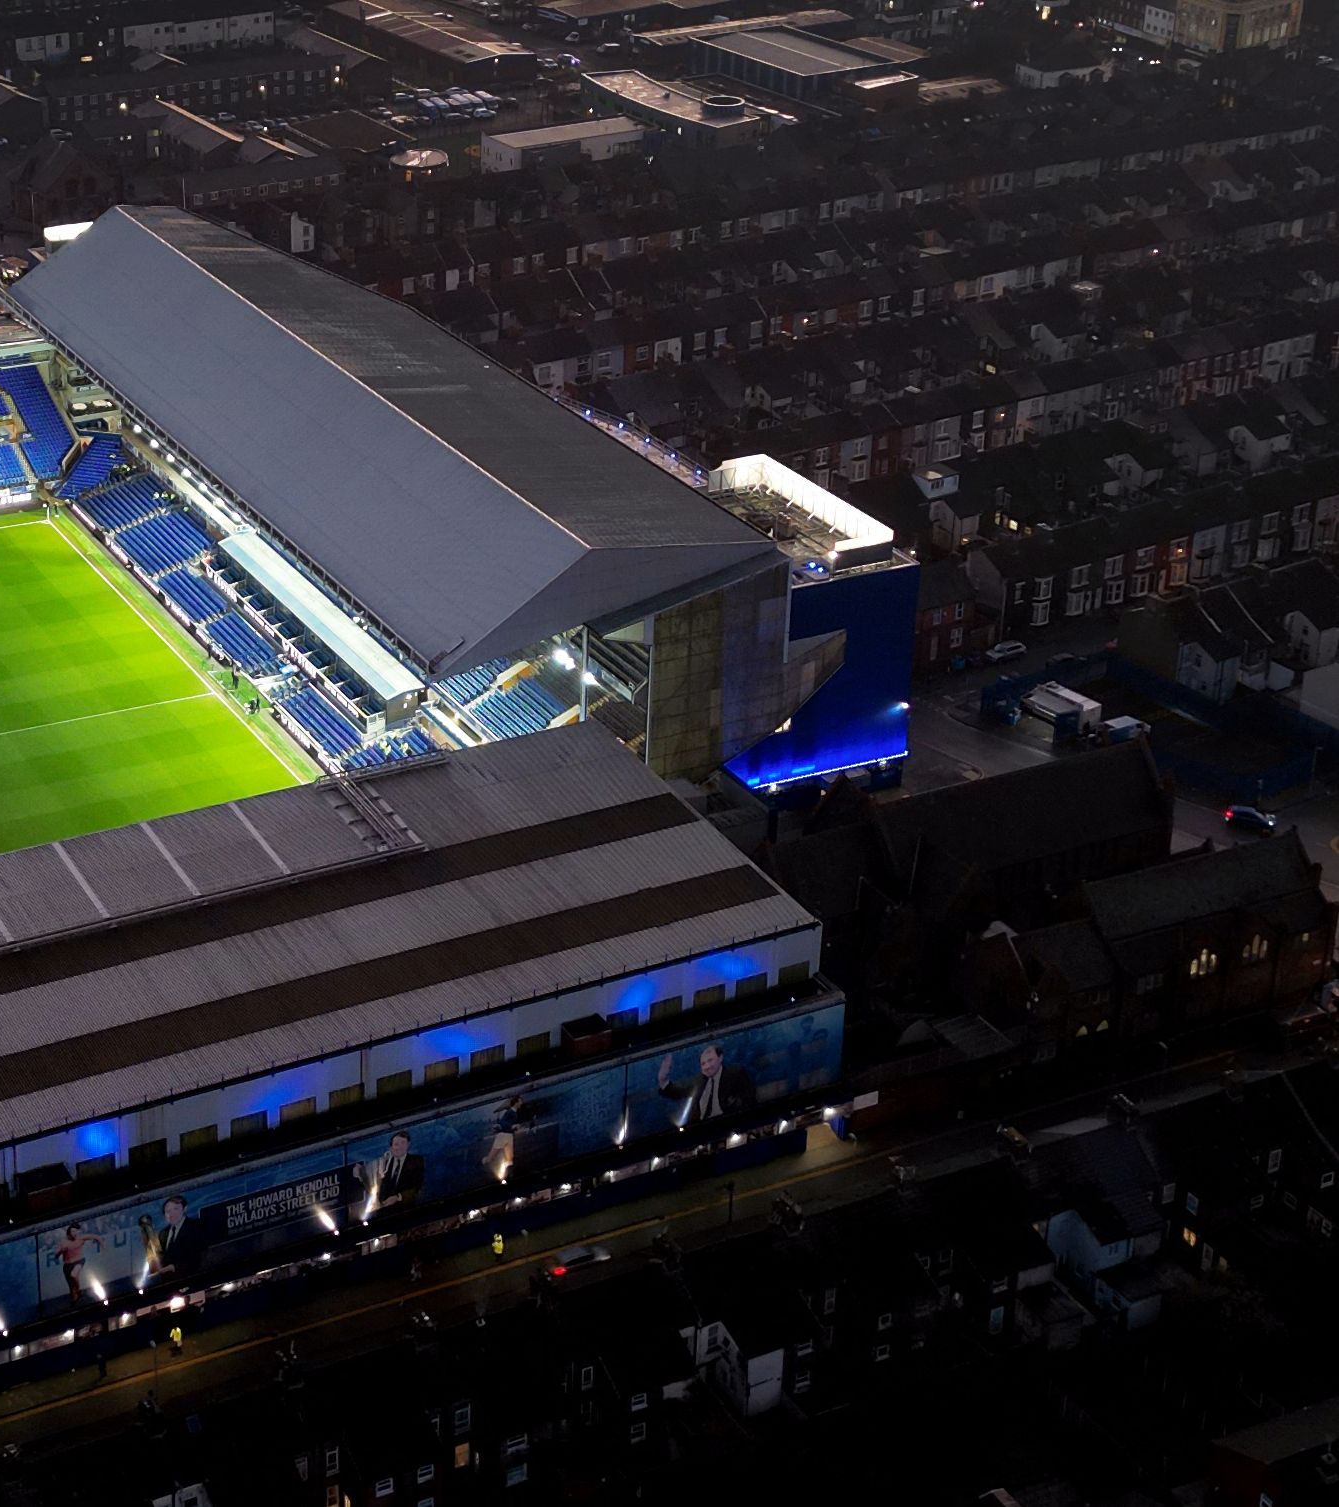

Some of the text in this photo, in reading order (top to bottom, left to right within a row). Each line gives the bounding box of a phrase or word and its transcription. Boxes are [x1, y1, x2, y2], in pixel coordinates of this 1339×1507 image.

[226, 1173, 340, 1217] THE HOWARD KENDALL
[227, 1204, 277, 1229] GWLADYS
[279, 1191, 318, 1213] STREET
[320, 1185, 340, 1201] END
